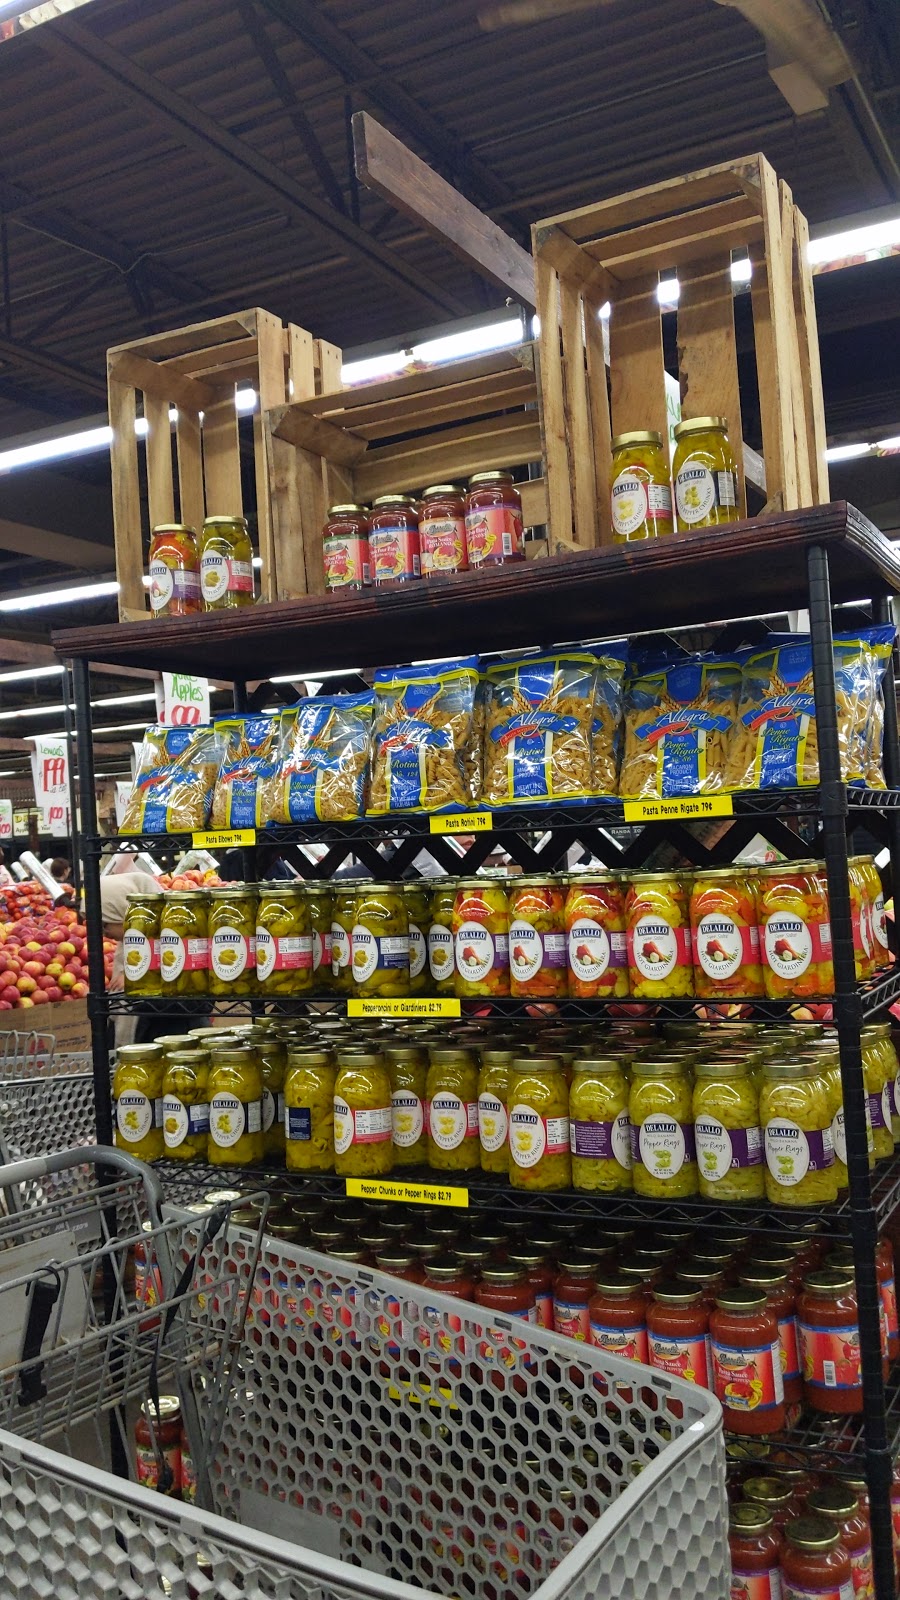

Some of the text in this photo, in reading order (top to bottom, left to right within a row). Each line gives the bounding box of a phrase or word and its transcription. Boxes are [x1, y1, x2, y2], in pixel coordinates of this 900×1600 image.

[171, 674, 204, 702] Apples
[761, 689, 815, 720] Allegra
[508, 710, 558, 737] Allegra
[656, 708, 709, 734] Allegra
[642, 802, 713, 816] Pasta Penne Rigate 79¢
[445, 818, 460, 828] Pasta
[460, 816, 476, 828] Rotini
[205, 835, 217, 844] Pasta
[218, 834, 233, 843] Elbows
[638, 926, 668, 935] DELALLO
[701, 923, 733, 933] DELALLO
[768, 923, 802, 933] DELALLO
[459, 931, 486, 940] DELALLO
[572, 929, 600, 938] DELALLO
[362, 1003, 442, 1013] Pepperoncini or Giardiniera $2.79
[213, 1100, 239, 1108] DELALLO
[644, 1124, 676, 1132] DELALLO
[768, 1128, 798, 1138] DELALLO
[643, 1138, 681, 1149] Pepper Rings
[709, 1142, 727, 1153] Rings
[785, 1144, 804, 1156] Rings
[360, 1184, 452, 1201] Pepper Chunks or Pepper Rings $2.79
[665, 1359, 682, 1368] Sauce
[731, 1370, 749, 1379] Sauce
